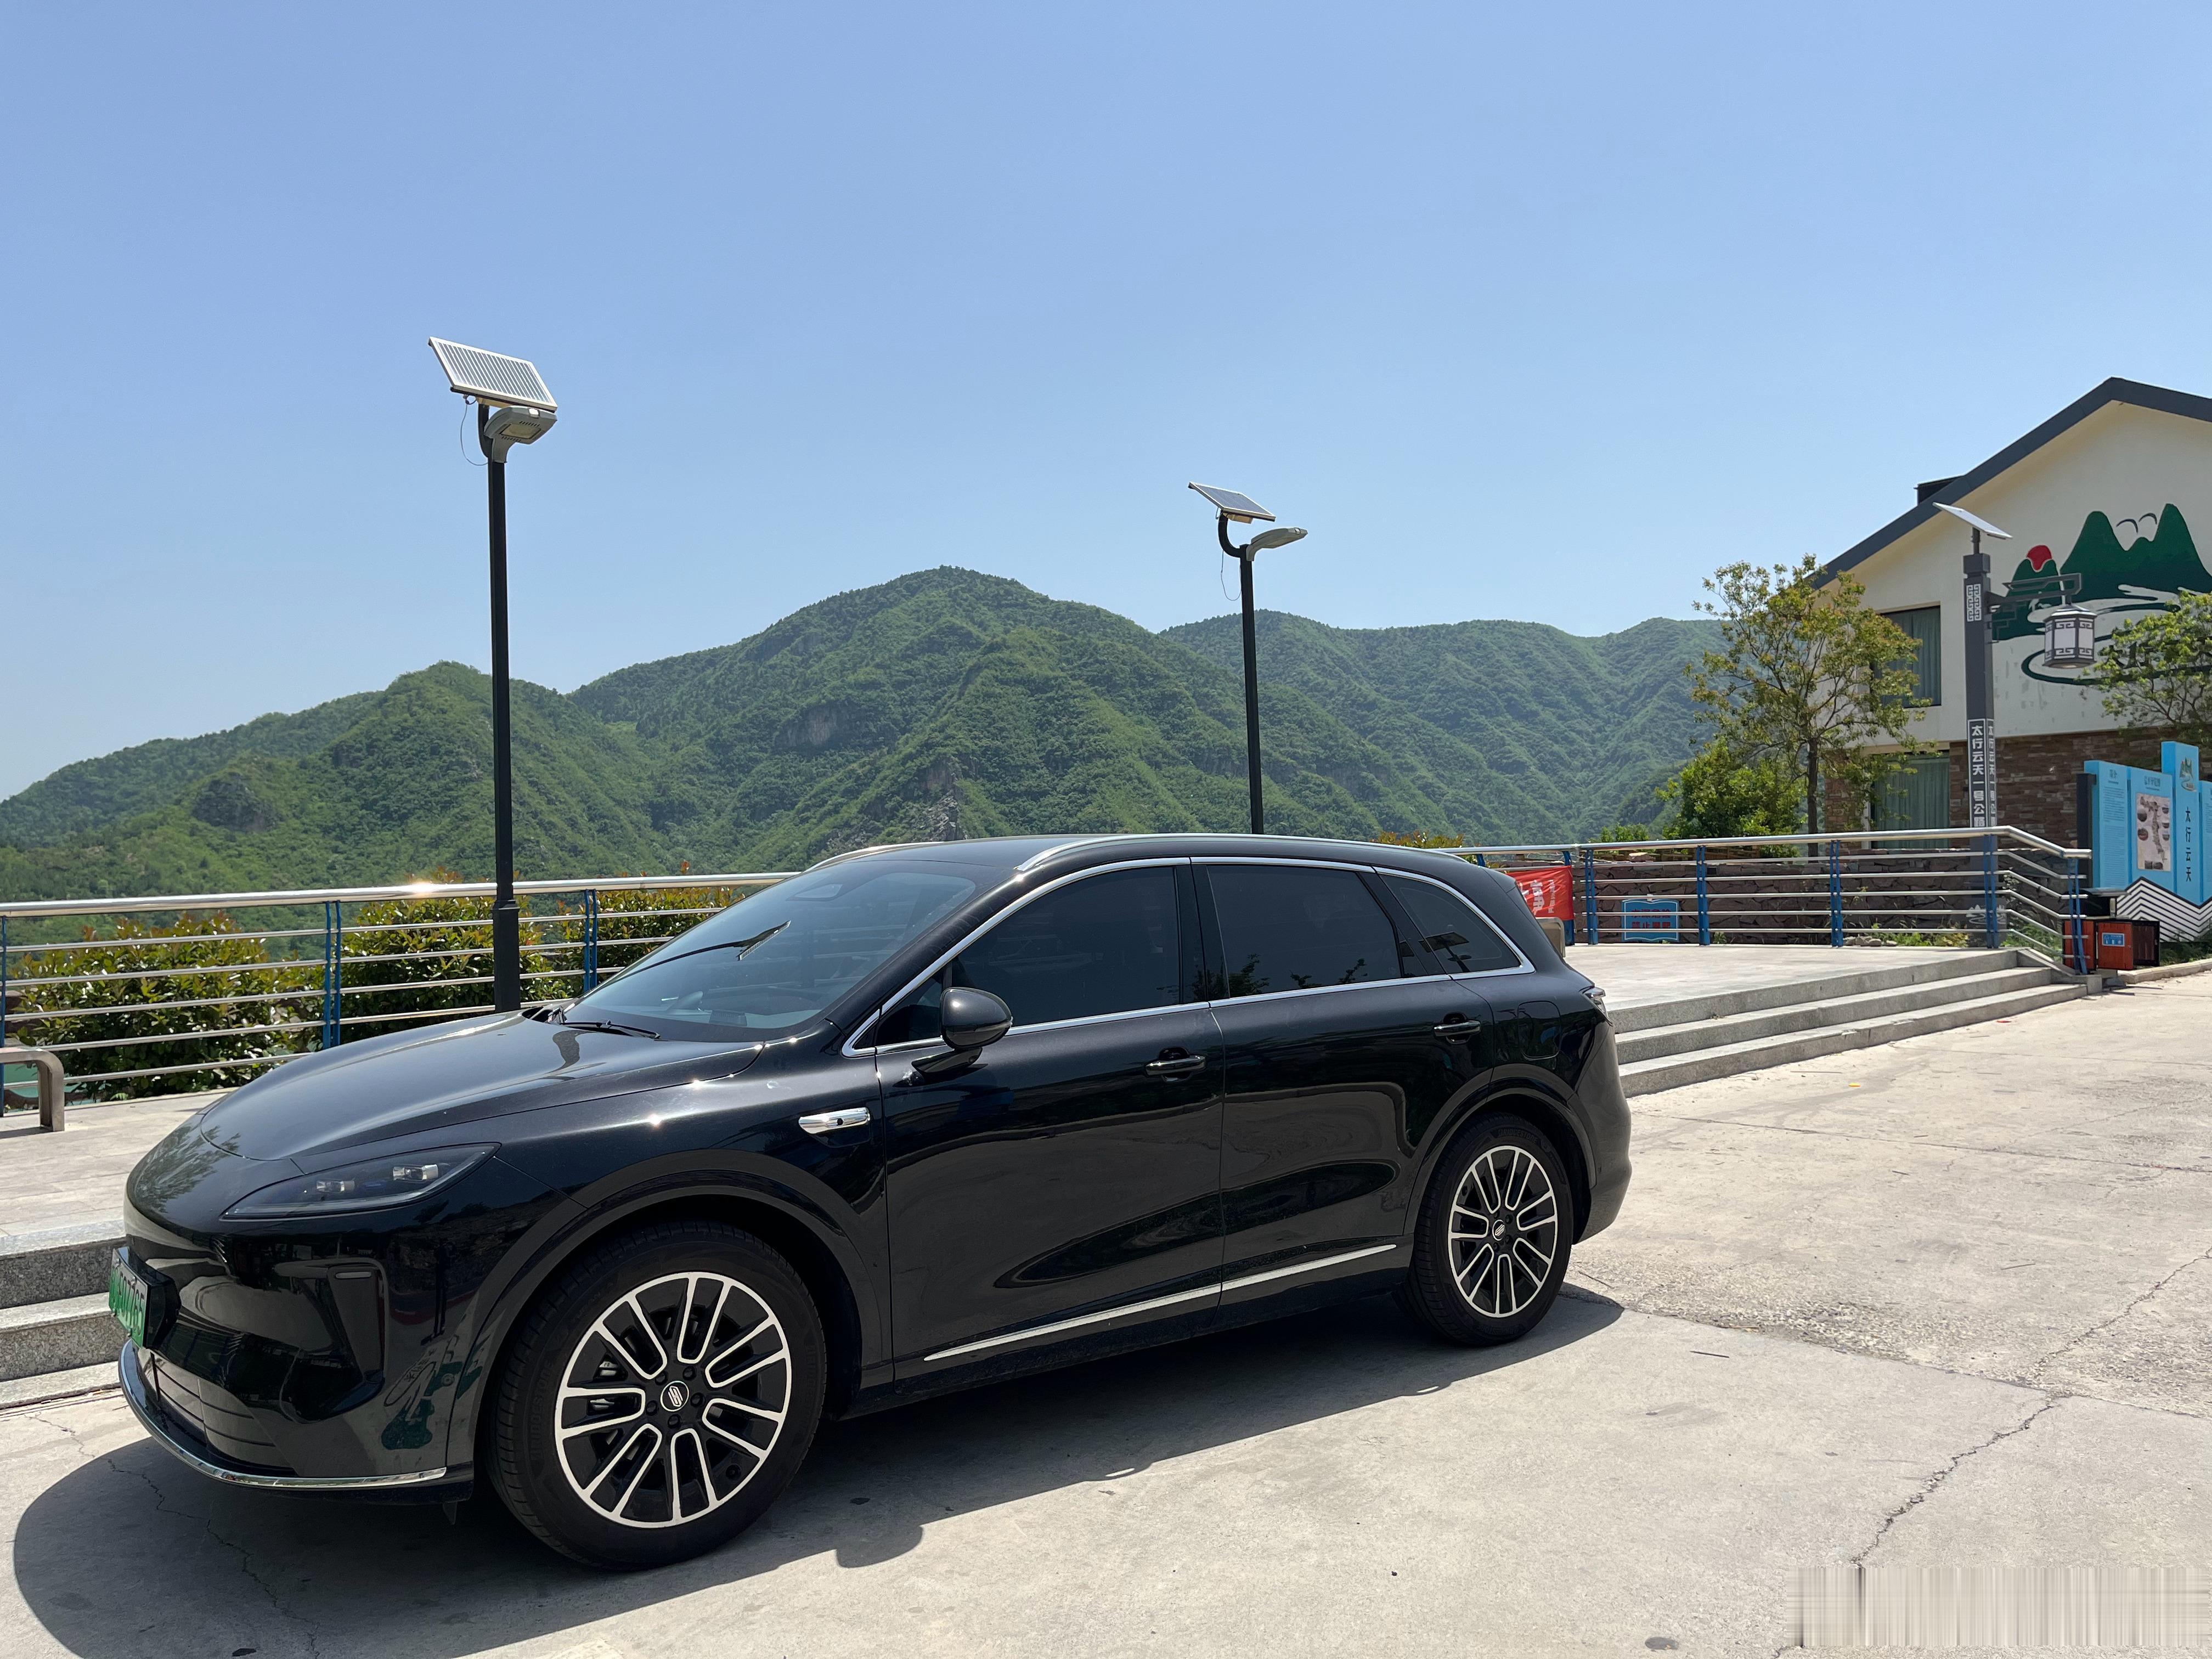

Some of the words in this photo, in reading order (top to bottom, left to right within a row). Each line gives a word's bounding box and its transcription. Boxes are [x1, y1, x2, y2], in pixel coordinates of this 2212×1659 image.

[1971, 725, 1985, 827] 太行云天一号公路
